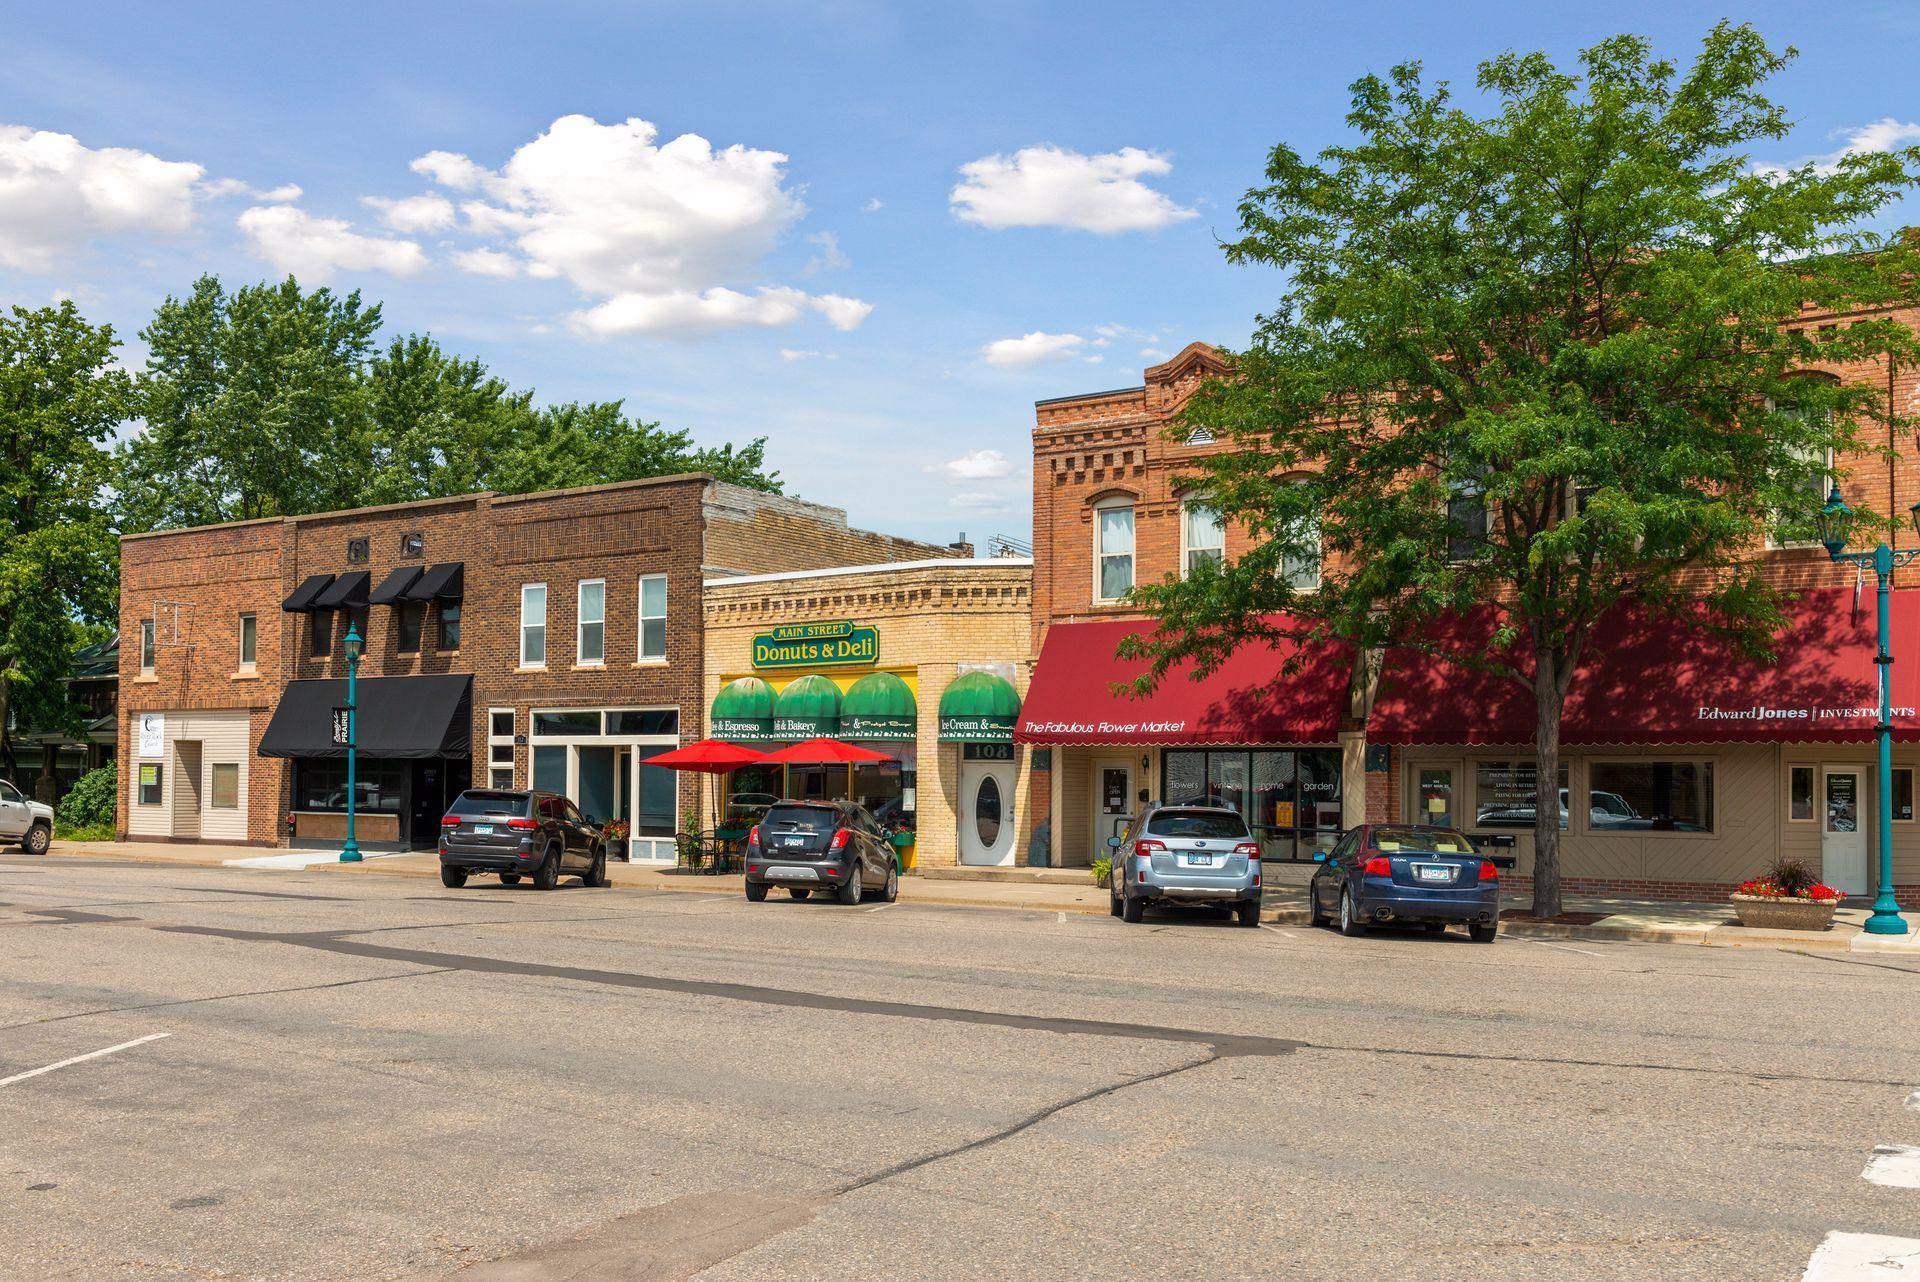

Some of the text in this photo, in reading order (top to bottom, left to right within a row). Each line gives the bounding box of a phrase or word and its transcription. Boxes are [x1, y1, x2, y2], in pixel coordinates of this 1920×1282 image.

[779, 624, 845, 638] MAIN STREET
[756, 638, 872, 662] Donuts & Deli
[1698, 706, 1916, 720] Edward Jones INVESTMNTS
[717, 720, 724, 731] &
[724, 720, 760, 733] Espresso
[780, 720, 787, 731] &
[787, 719, 816, 733] Bakery
[853, 718, 860, 729] &
[941, 719, 950, 730] Ice
[949, 718, 979, 730] Cream
[980, 718, 989, 730] &
[1025, 721, 1044, 733] The
[1044, 721, 1094, 733] Fabulous
[1098, 721, 1138, 733] Flower
[1140, 720, 1186, 733] Market
[975, 744, 1008, 759] 108
[1171, 780, 1334, 791] flowers vintage home garden
